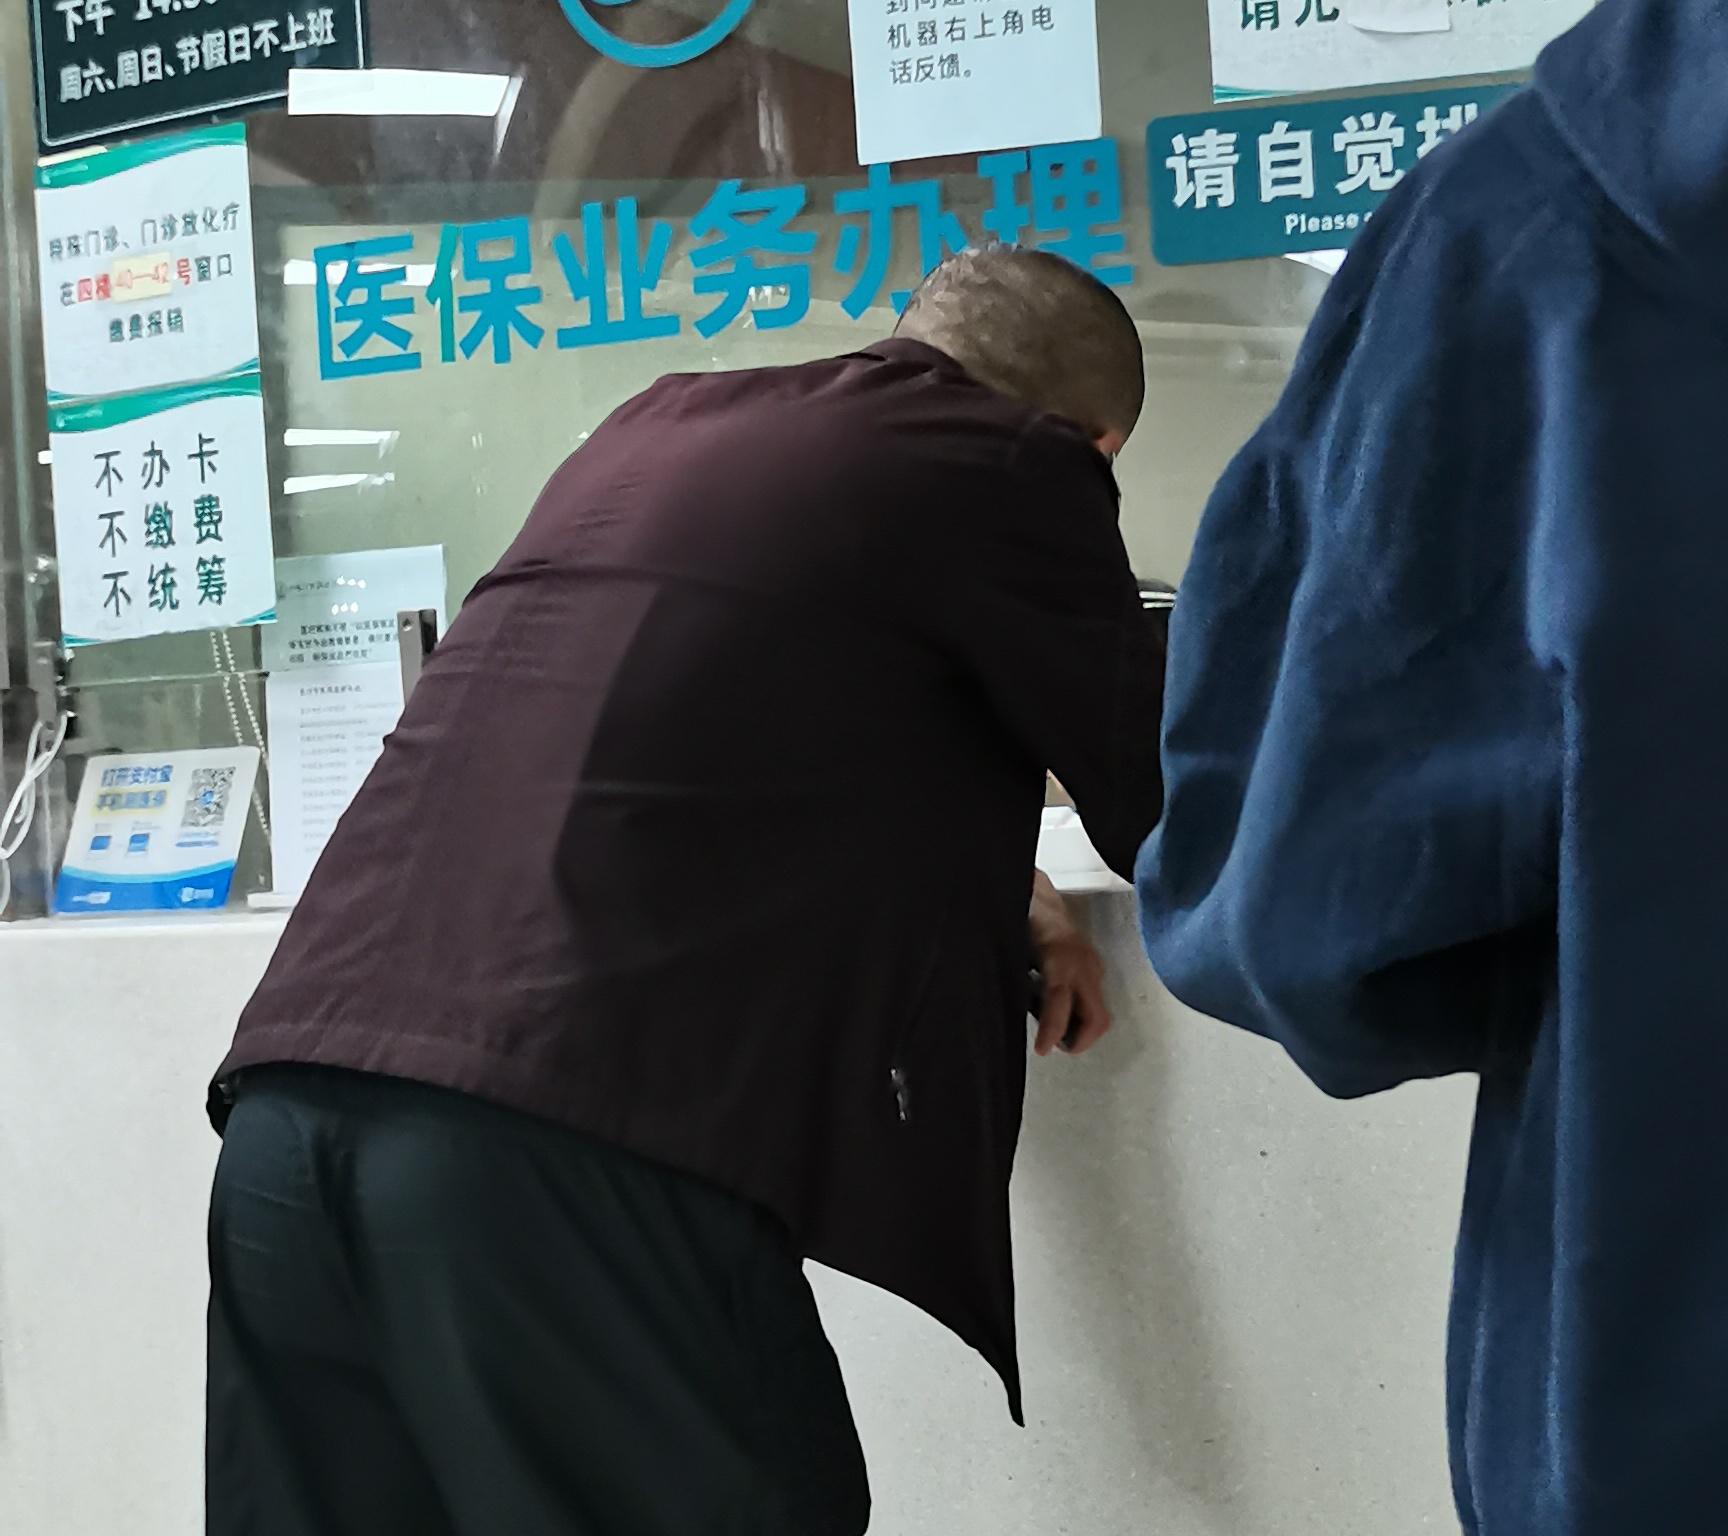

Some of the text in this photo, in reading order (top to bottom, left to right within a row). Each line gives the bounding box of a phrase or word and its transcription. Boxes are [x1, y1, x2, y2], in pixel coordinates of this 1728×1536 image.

[887, 5, 1055, 50] 机器右上角电
[890, 52, 973, 86] 话反馈。
[1285, 213, 1359, 235] Please
[313, 137, 1135, 382] 医保业务办理
[94, 432, 220, 498] 不办卡
[97, 494, 224, 558] 不缴费
[101, 554, 228, 617] 不统筹
